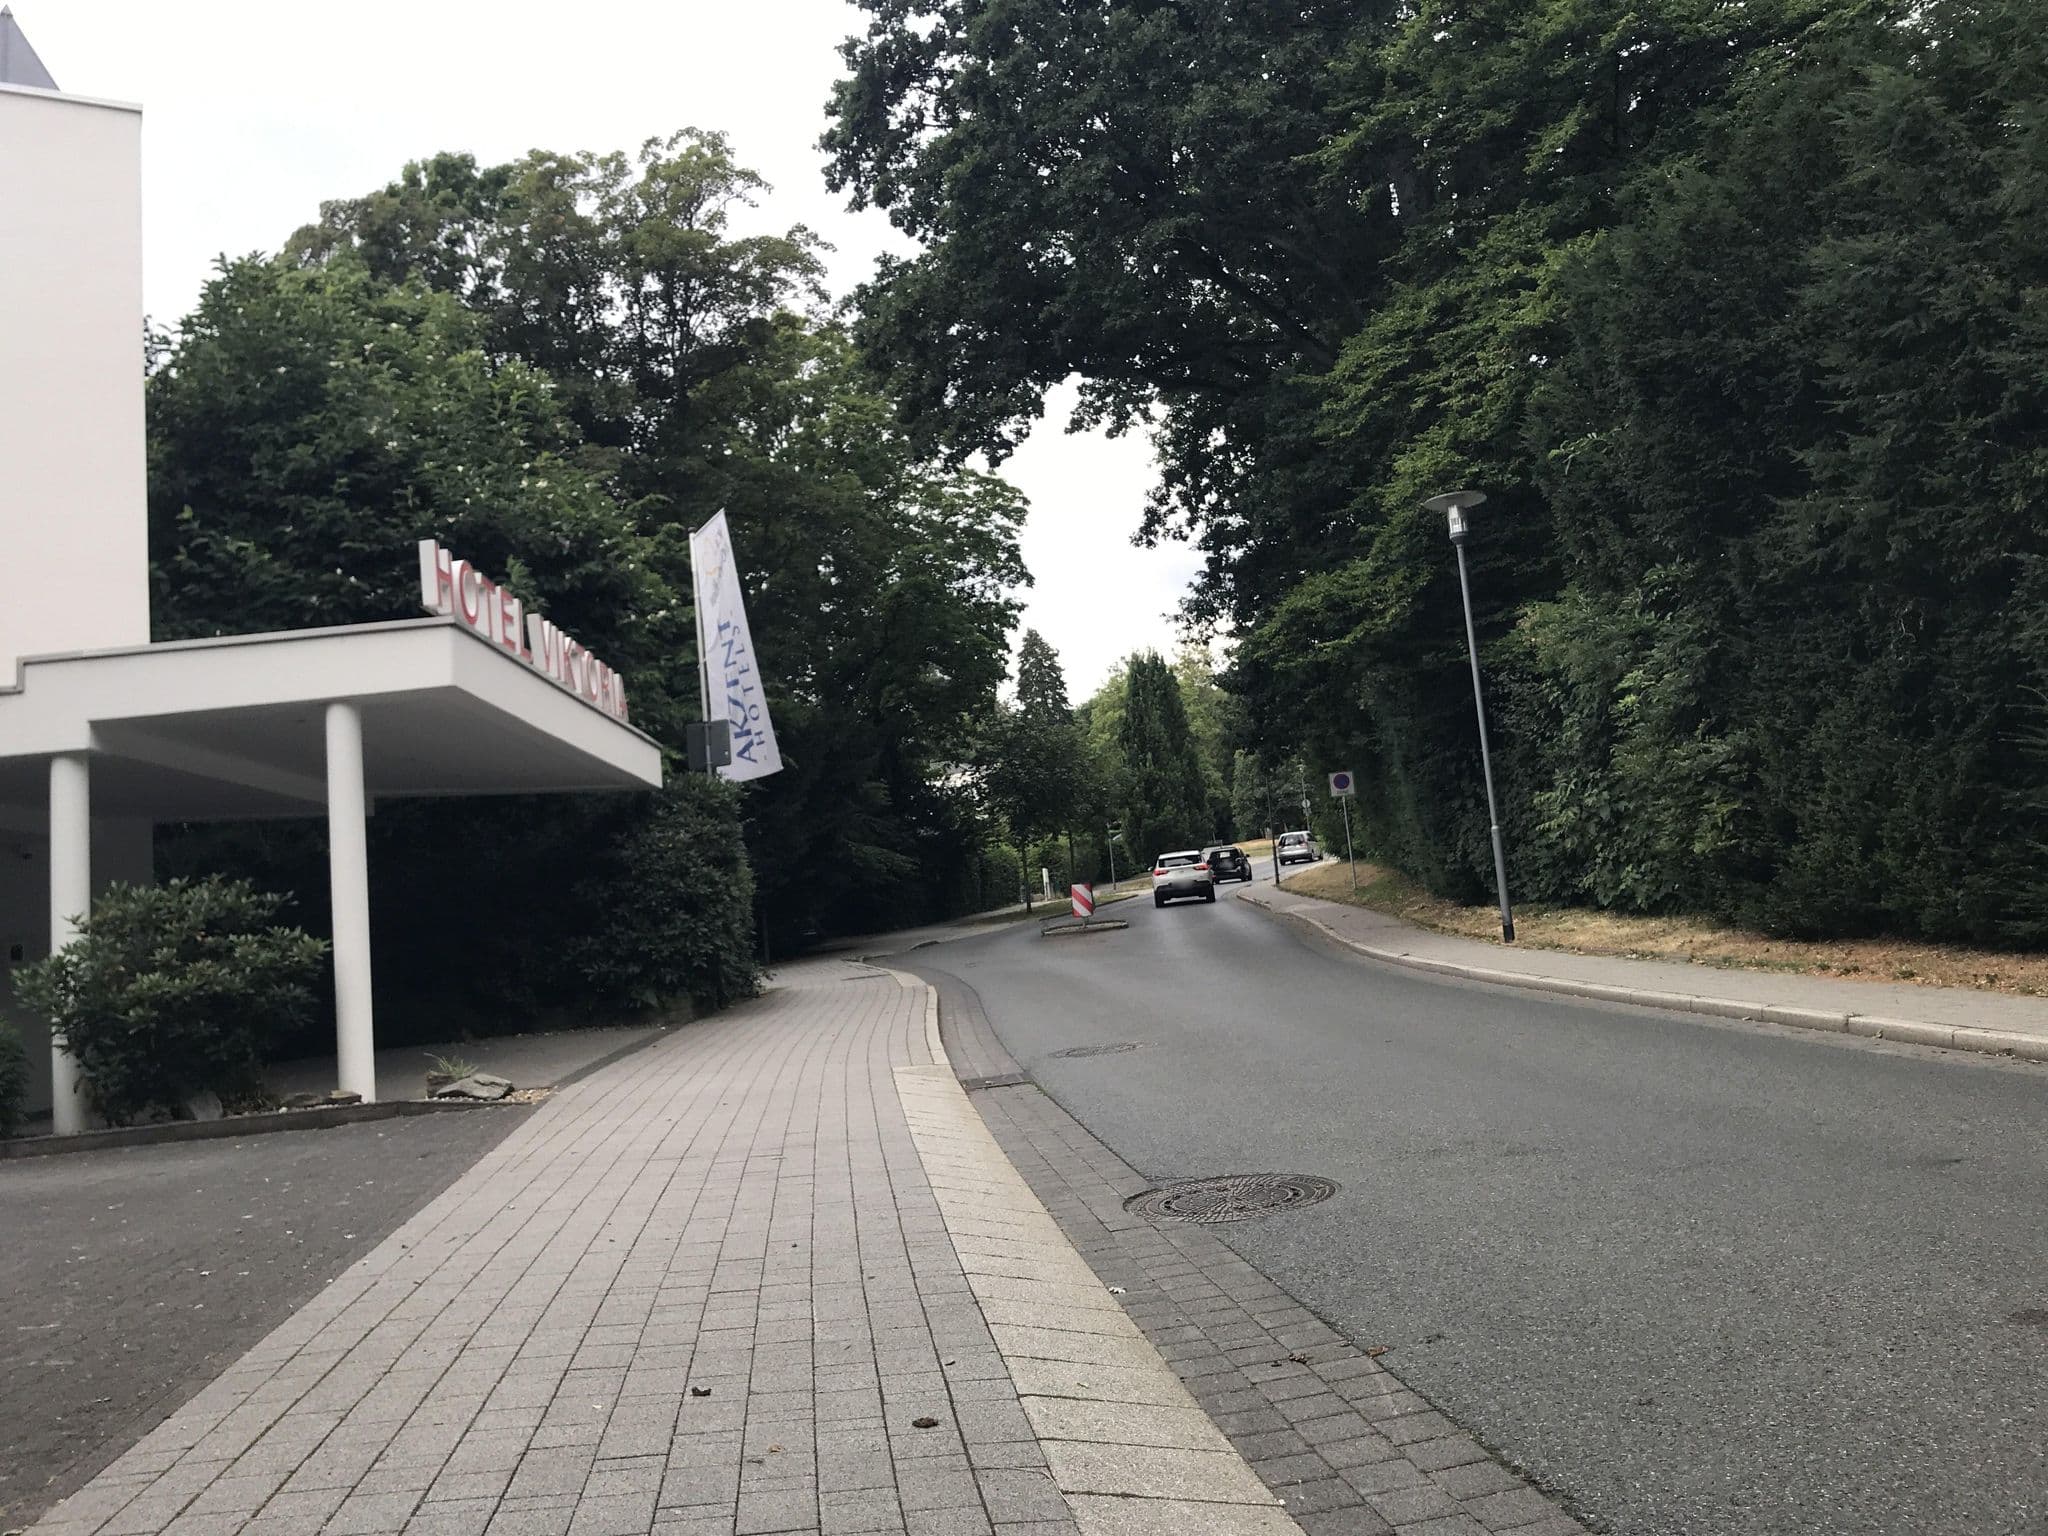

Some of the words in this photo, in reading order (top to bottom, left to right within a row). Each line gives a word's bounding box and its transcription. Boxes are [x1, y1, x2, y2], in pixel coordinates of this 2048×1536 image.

[418, 539, 533, 664] HOTEL
[527, 613, 629, 721] VIKTORIA
[717, 619, 758, 763] AKZENT
[732, 625, 765, 746] HOTELS
